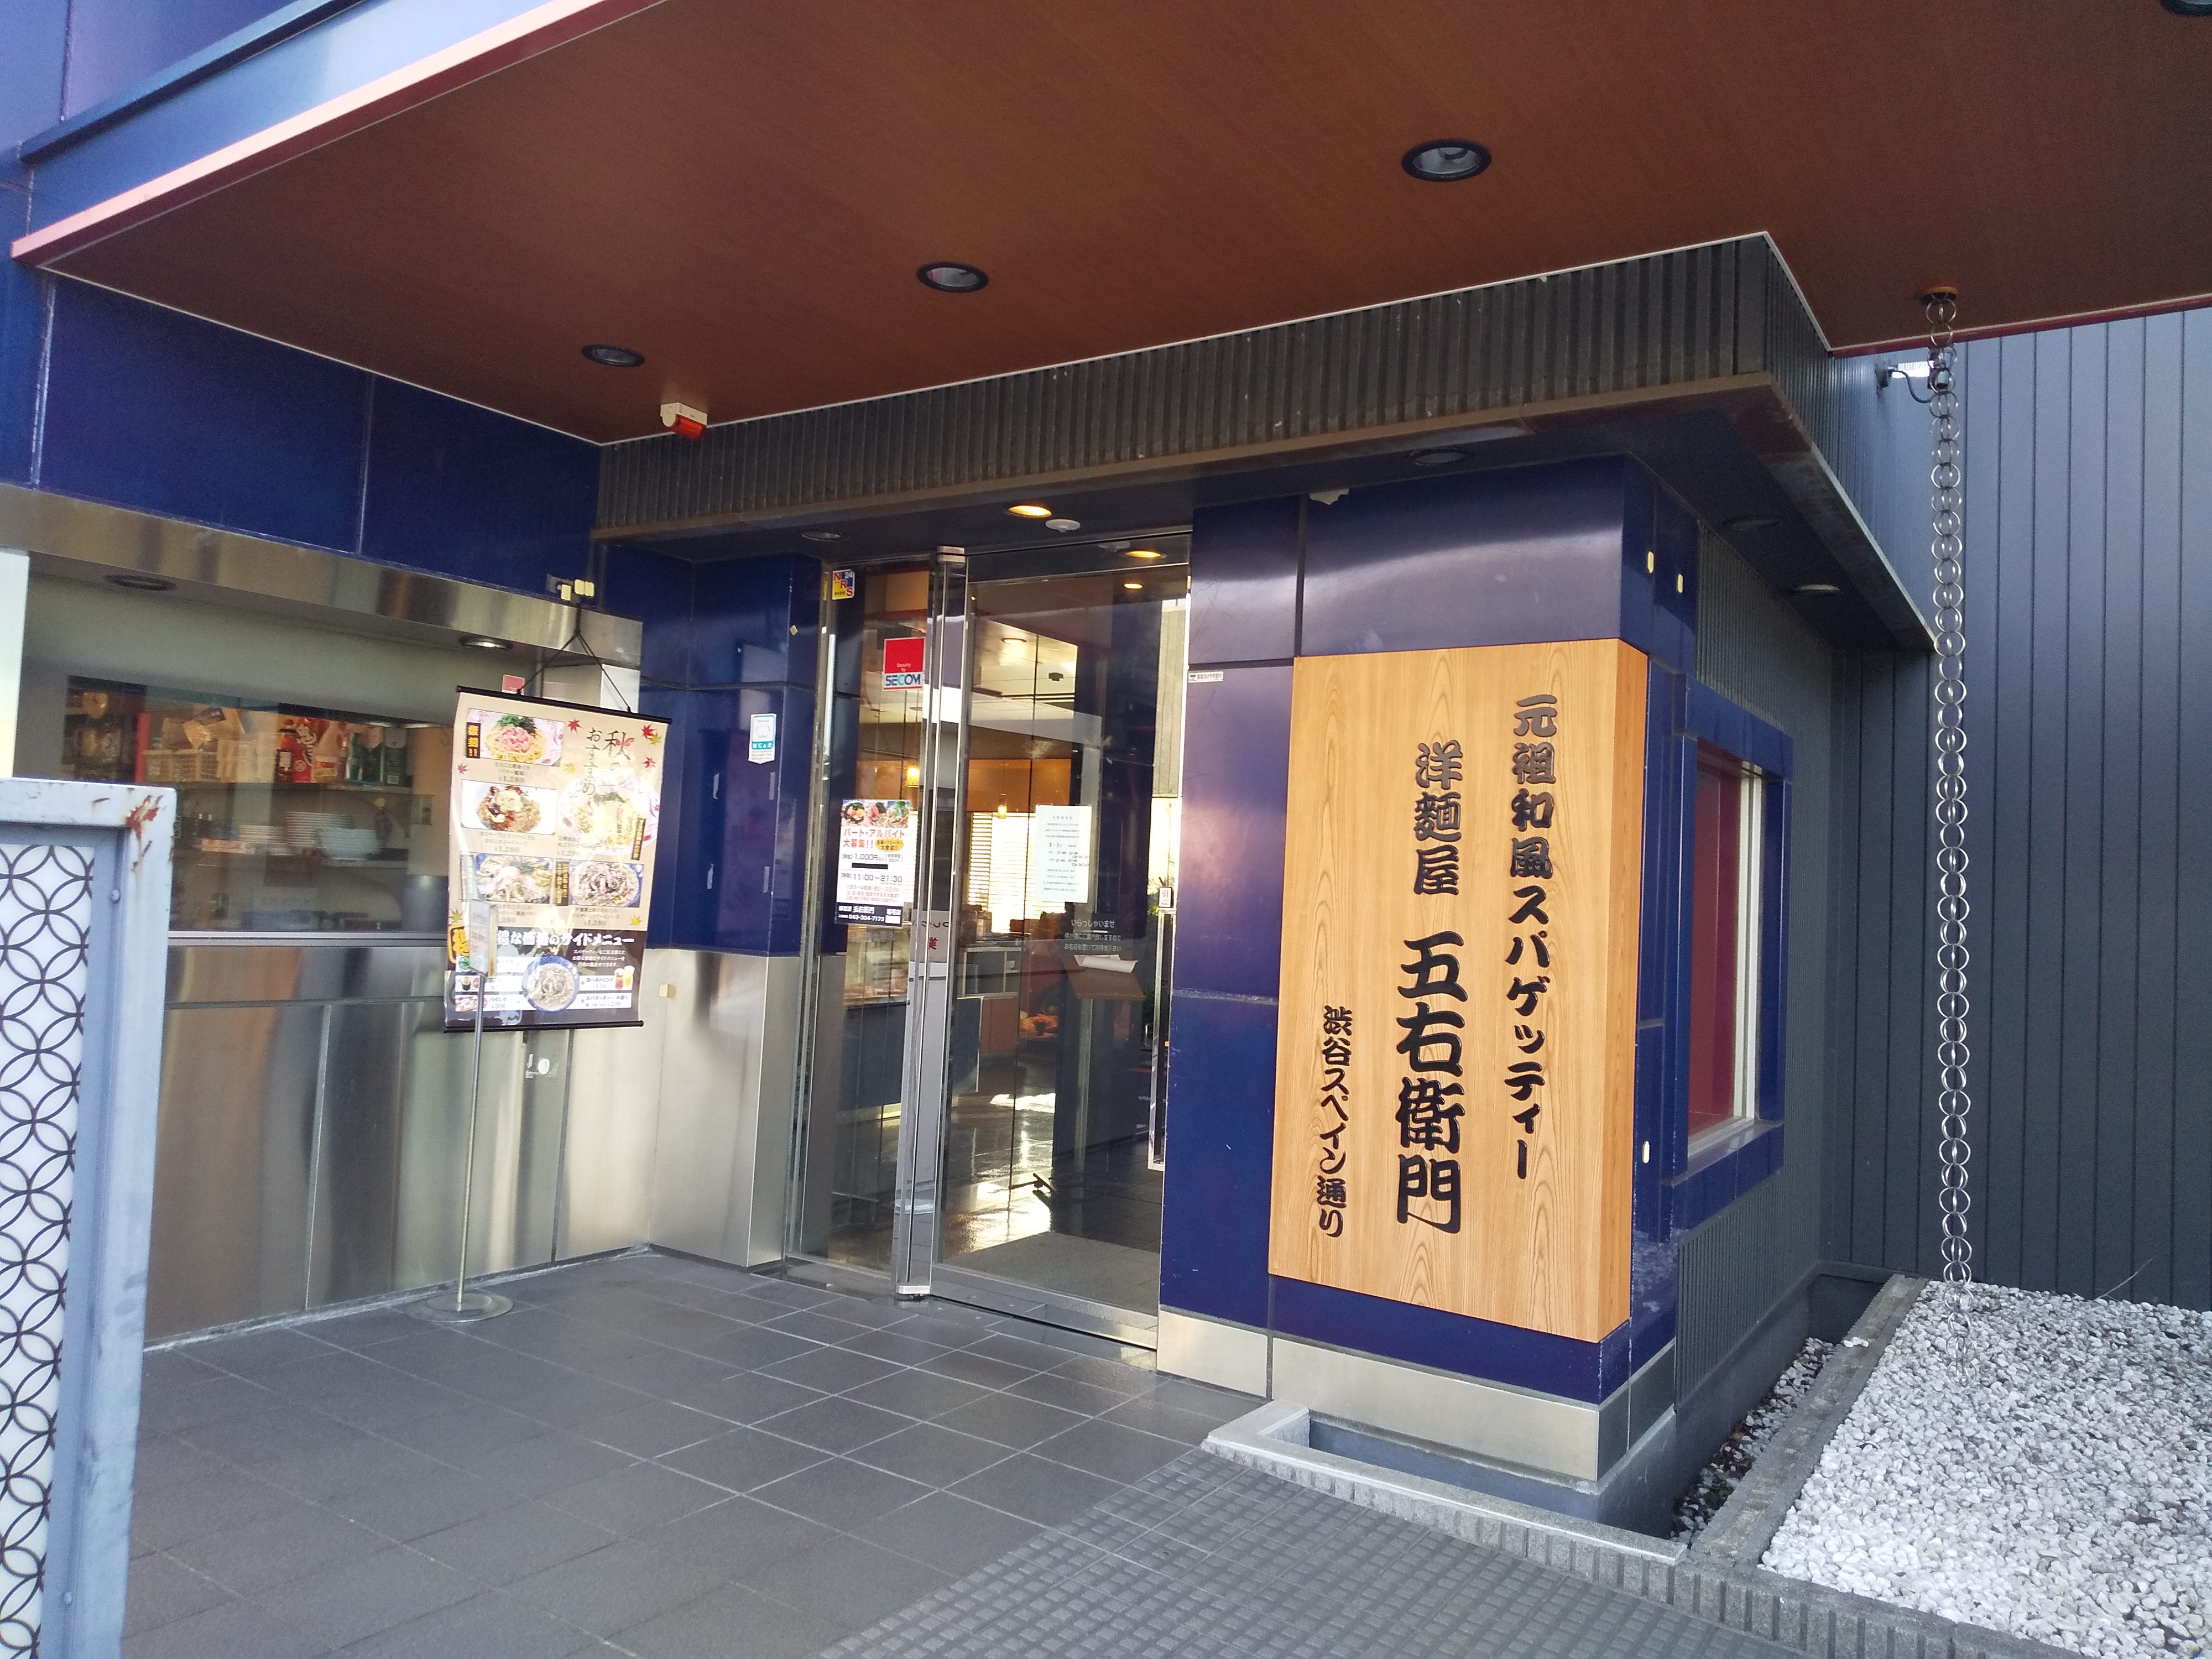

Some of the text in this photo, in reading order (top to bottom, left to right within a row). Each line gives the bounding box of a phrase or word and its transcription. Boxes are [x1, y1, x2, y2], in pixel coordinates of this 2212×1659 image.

[885, 674, 921, 686] SECOM
[843, 828, 905, 839] パート・アルバイト
[1071, 919, 1115, 928] いらっしゃいませ
[1505, 695, 1557, 1179] 元祖和風スパゲッティー
[1317, 1005, 1353, 1238] 渋谷スペイン通り
[1395, 931, 1467, 1233] 五右衛門
